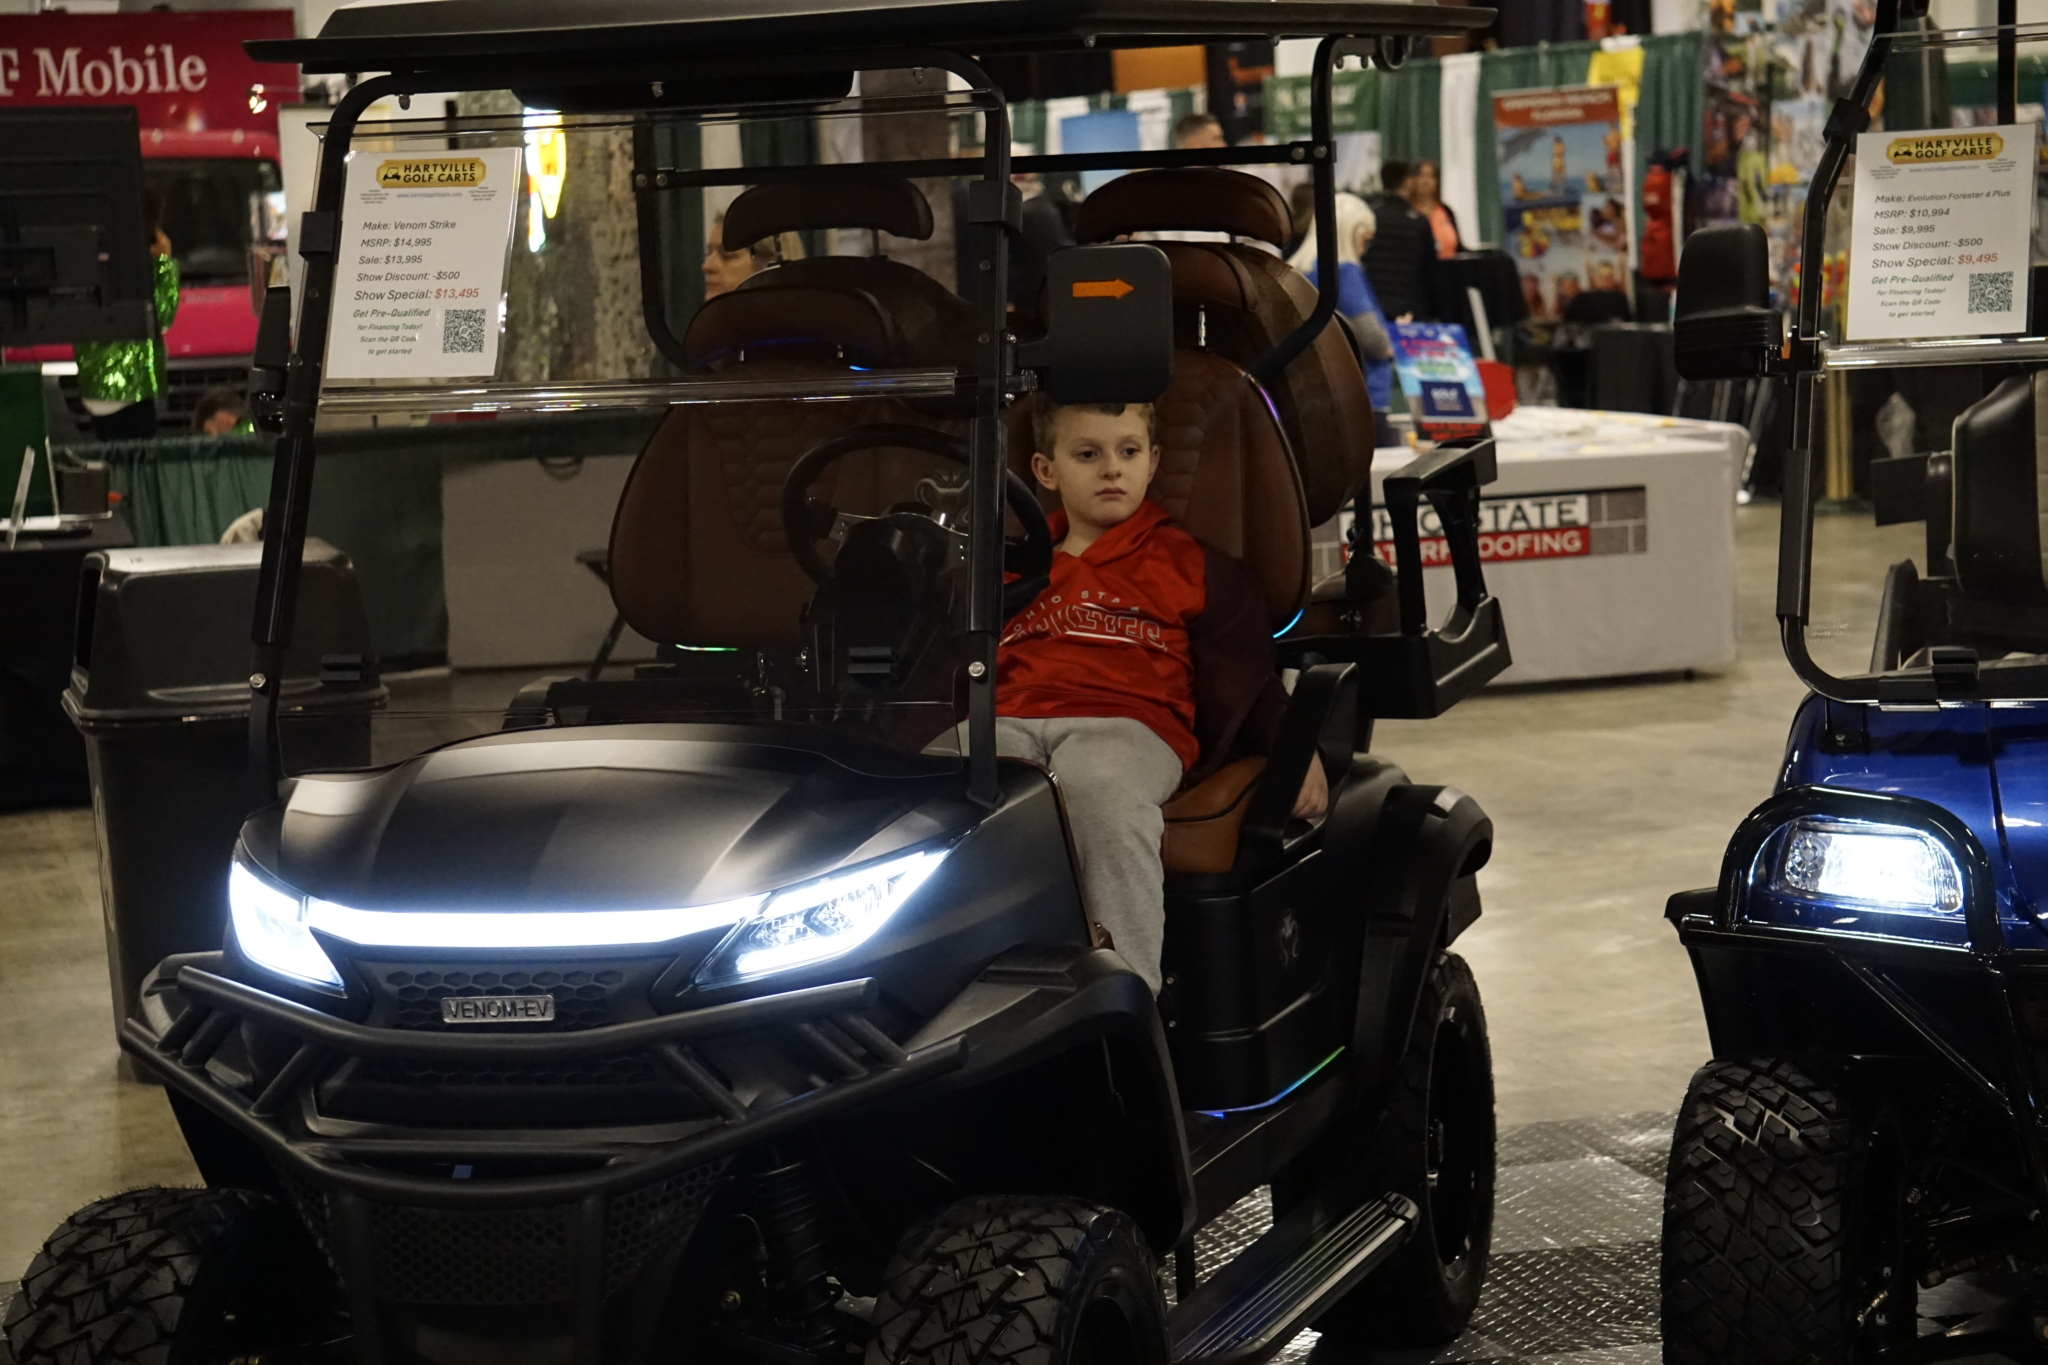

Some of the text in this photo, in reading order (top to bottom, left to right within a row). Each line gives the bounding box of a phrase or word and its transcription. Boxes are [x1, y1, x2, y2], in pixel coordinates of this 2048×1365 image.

[33, 43, 208, 98] Mobile
[1915, 137, 1993, 149] HARTVILLE
[1915, 146, 1993, 159] GOLF CARTS
[403, 162, 476, 174] HARTVILLE
[403, 172, 476, 183] GOLF CARTS
[1875, 189, 2011, 204] Make: Evolution Forester 4 Plus
[1874, 207, 1951, 220] MSRP: $10,994
[362, 219, 457, 231] Make: Venom Strike
[1873, 223, 1936, 236] Sale: $9,995
[360, 237, 433, 249] MSRP: $14,995
[1872, 236, 1984, 252] Show Discount: -$500
[358, 254, 423, 266] Sale: $13,995
[1871, 252, 1998, 270] Show Special: $9,495
[356, 270, 461, 282] Show Discount: -$500
[1871, 272, 1955, 285] Get Pre-Qualified
[354, 287, 480, 302] Show Special: $13,495
[1876, 286, 1946, 298] for Financing Today!
[1898, 299, 1910, 307] the
[1911, 298, 1923, 306] QR
[1924, 298, 1941, 306] Code
[353, 307, 431, 318] Get Pre-Qualified
[1897, 310, 1909, 319] get
[1910, 309, 1936, 318] started
[357, 322, 423, 333] for Financing Today!
[359, 335, 377, 343] Scan
[377, 335, 388, 343] the
[389, 335, 400, 343] QR
[375, 348, 387, 357] get
[387, 347, 412, 355] started
[1476, 498, 1581, 532] TATE
[1013, 596, 1062, 632] OHIO
[448, 1000, 549, 1018] VENOM-EV
